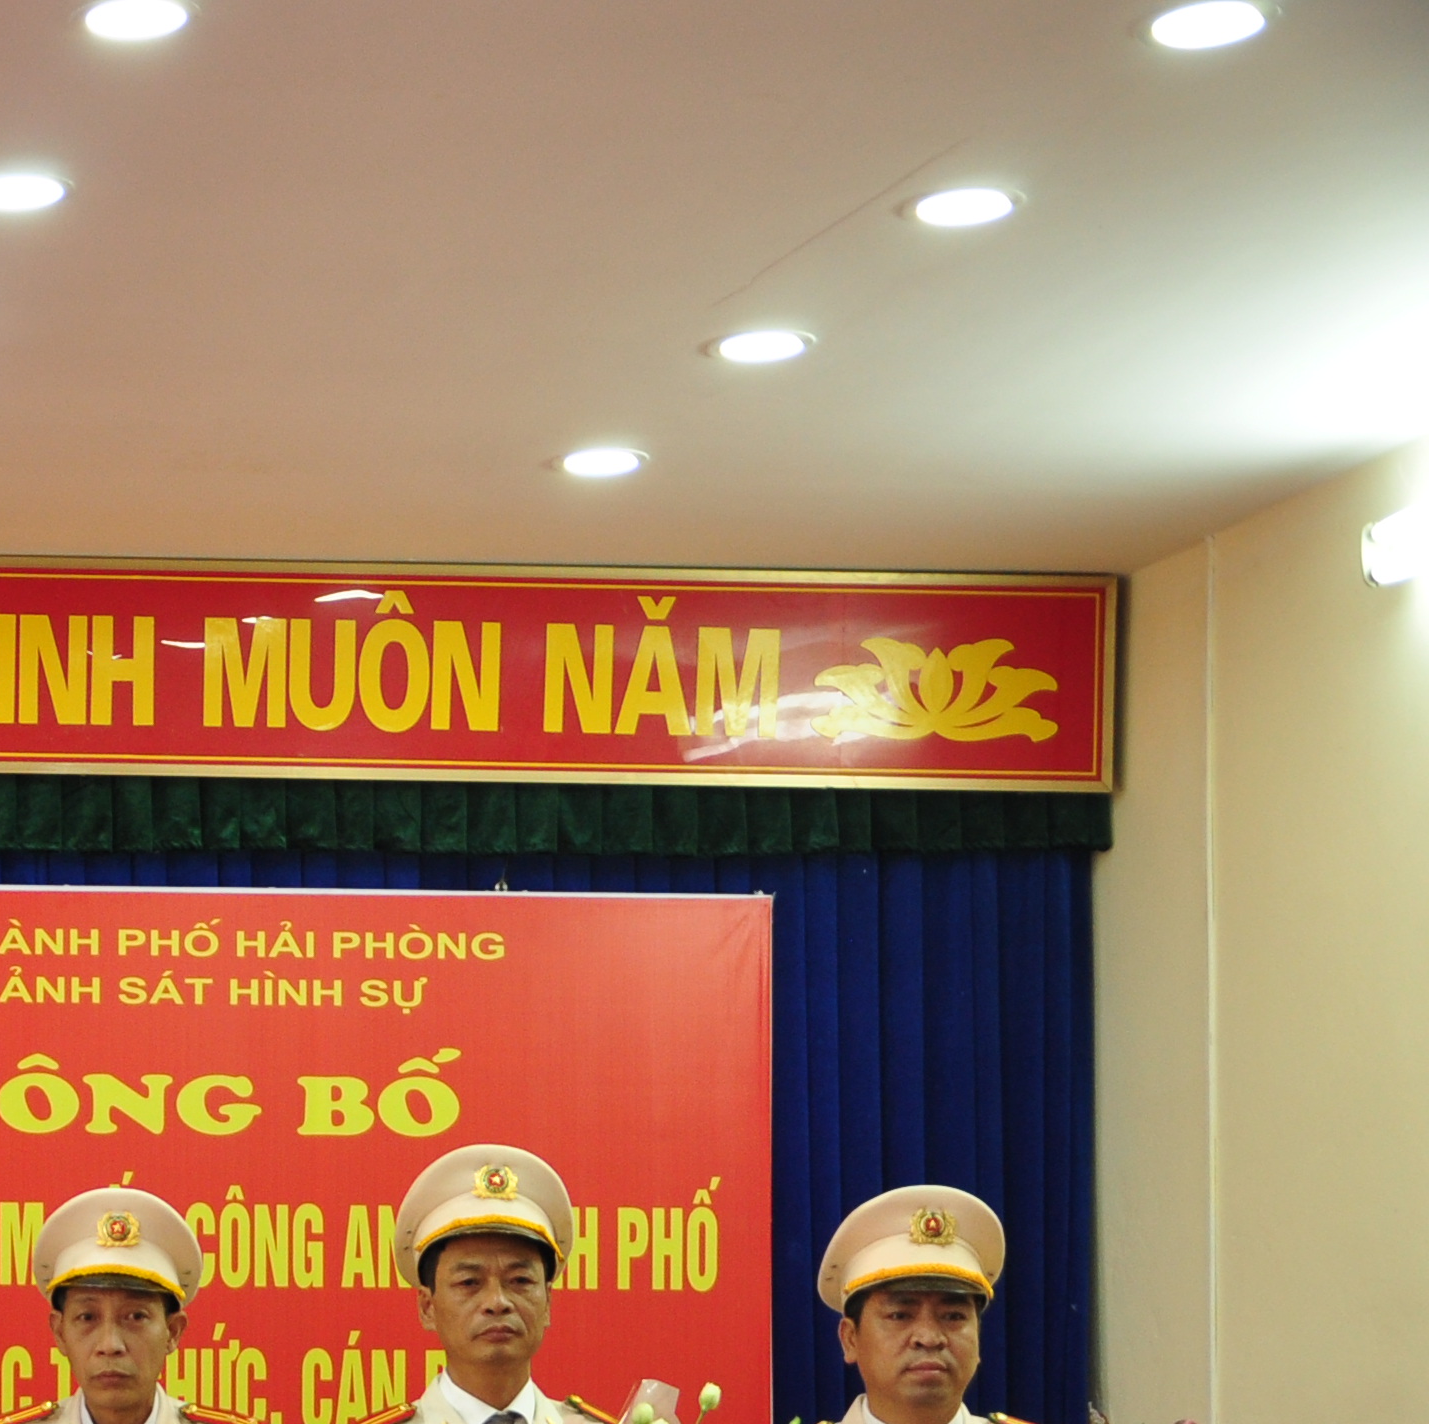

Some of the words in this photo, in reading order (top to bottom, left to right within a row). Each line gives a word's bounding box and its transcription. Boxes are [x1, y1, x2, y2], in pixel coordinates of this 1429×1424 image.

[203, 590, 502, 733] MUÔN
[544, 596, 783, 738] NĂM
[117, 919, 221, 957] PHỐ
[236, 921, 315, 958] HẢI
[333, 924, 506, 960] PHÒNG
[118, 971, 213, 1005] SÁT
[230, 971, 343, 1007] HÌNH
[360, 977, 428, 1014] SỰ
[297, 1048, 462, 1138] BỐ
[184, 1185, 325, 1289] CÔNG
[617, 1176, 722, 1293] PHỐ
